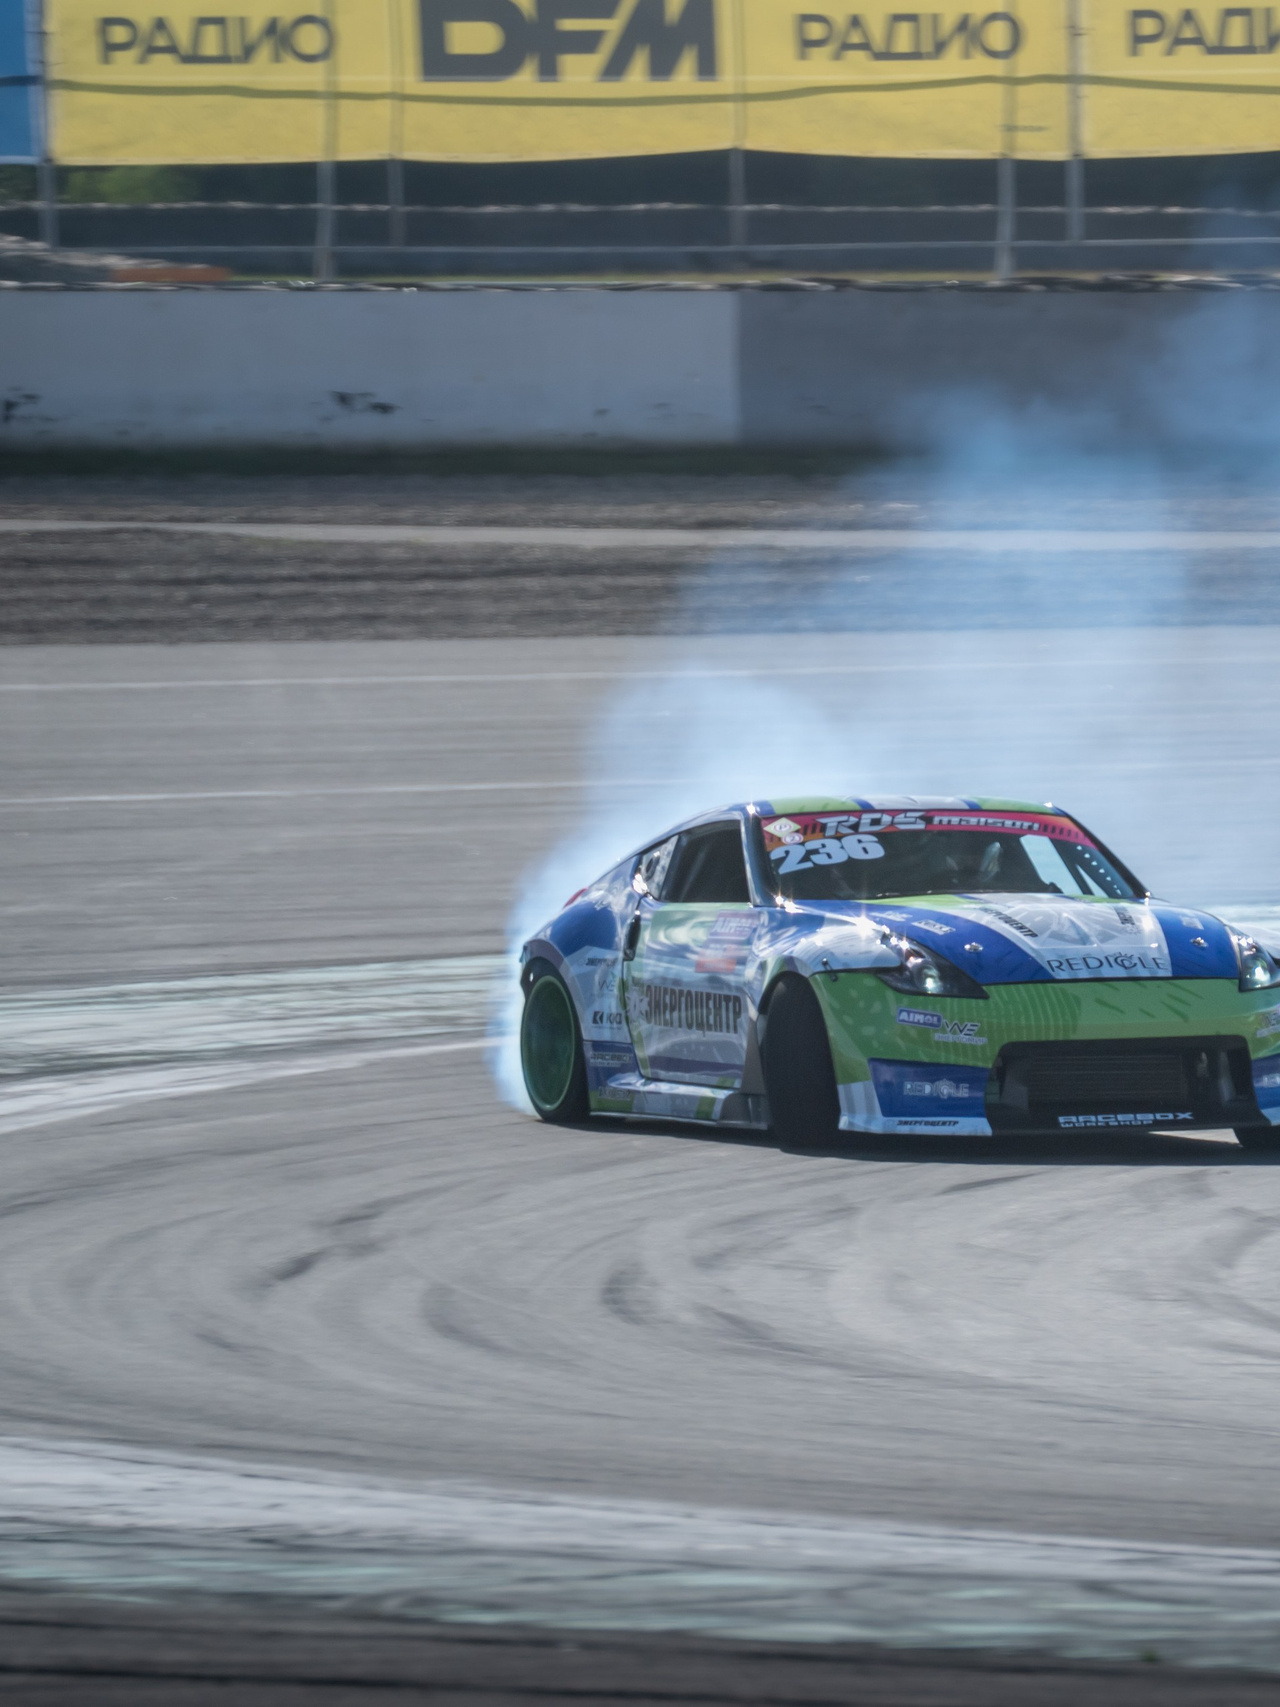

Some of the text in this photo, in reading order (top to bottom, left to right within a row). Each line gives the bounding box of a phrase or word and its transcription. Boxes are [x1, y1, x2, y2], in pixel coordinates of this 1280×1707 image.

[98, 15, 335, 65] РАДИО
[419, 0, 718, 82] DFM
[797, 12, 1025, 60] РАДИО
[815, 812, 926, 837] RDS
[769, 834, 885, 875] 236
[644, 984, 742, 1037] ЭНЕРГОЦЕНТР
[900, 1011, 940, 1025] AIMOL
